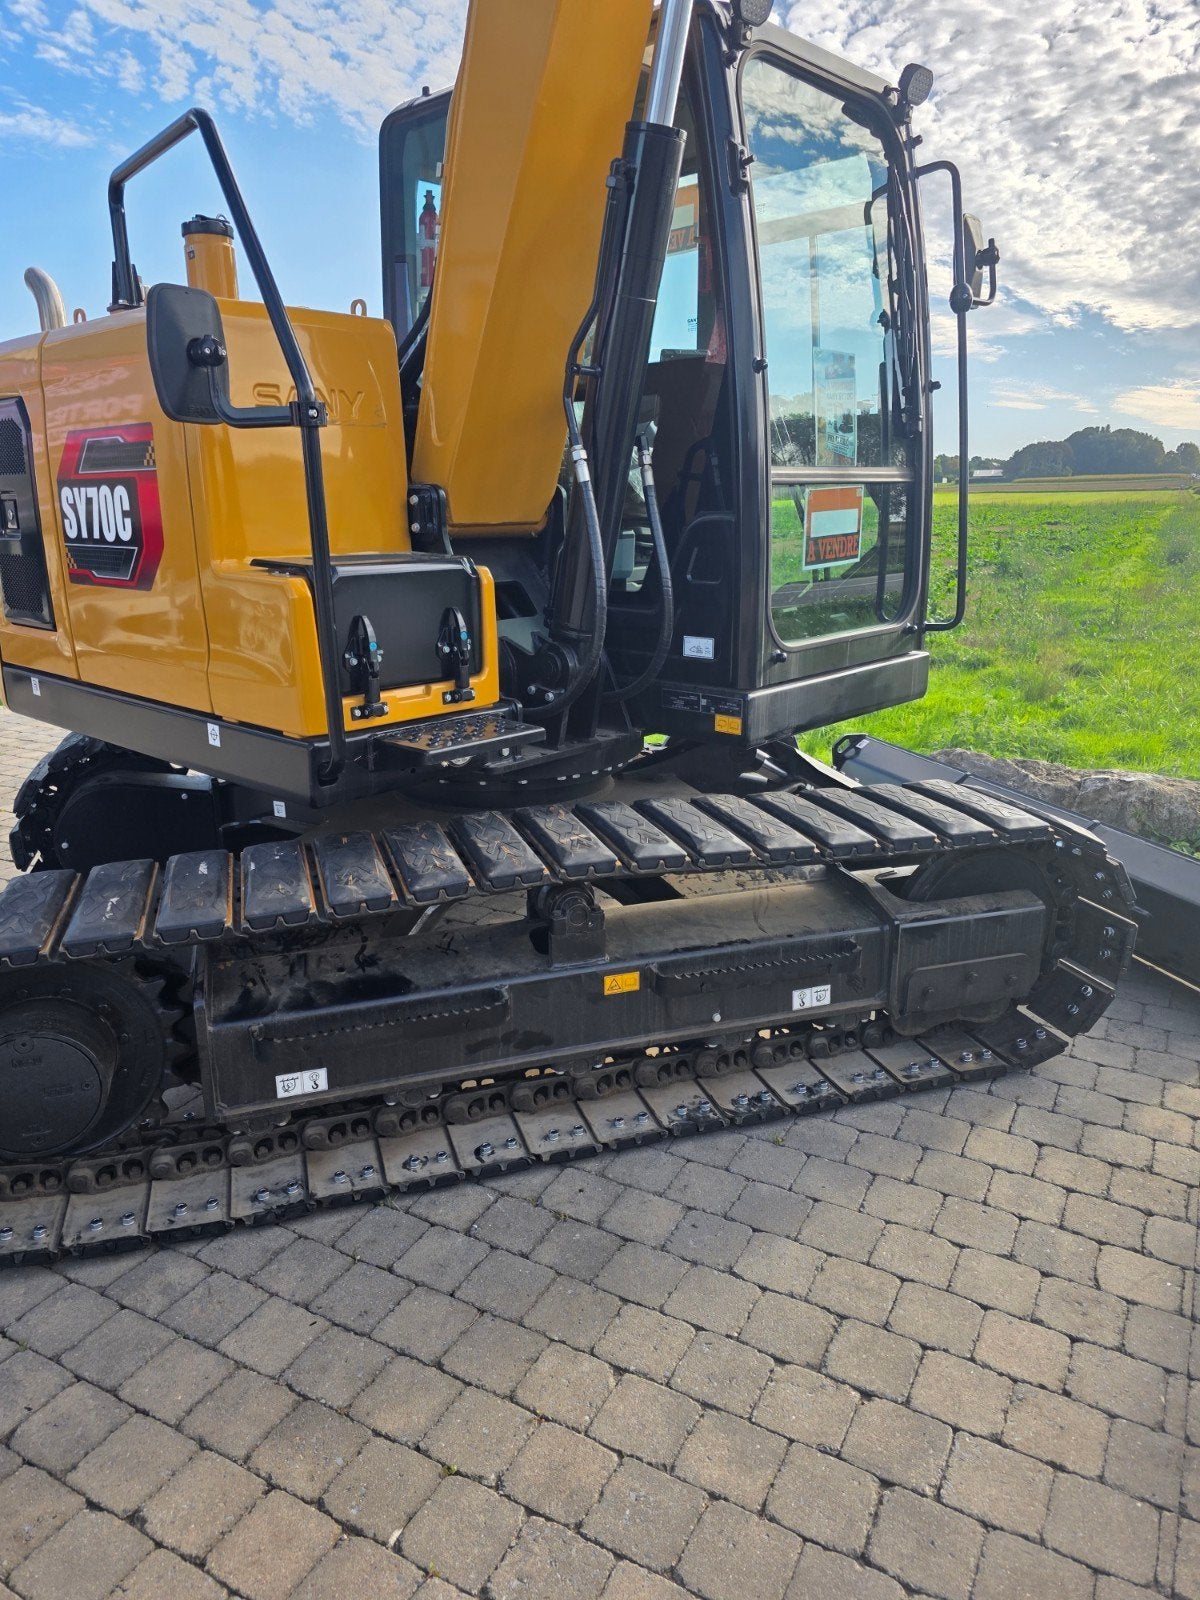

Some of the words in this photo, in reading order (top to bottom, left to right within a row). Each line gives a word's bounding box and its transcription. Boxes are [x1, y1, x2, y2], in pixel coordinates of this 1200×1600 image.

[60, 484, 132, 543] SY70C
[807, 540, 816, 562] A
[818, 535, 860, 560] VENDRE
